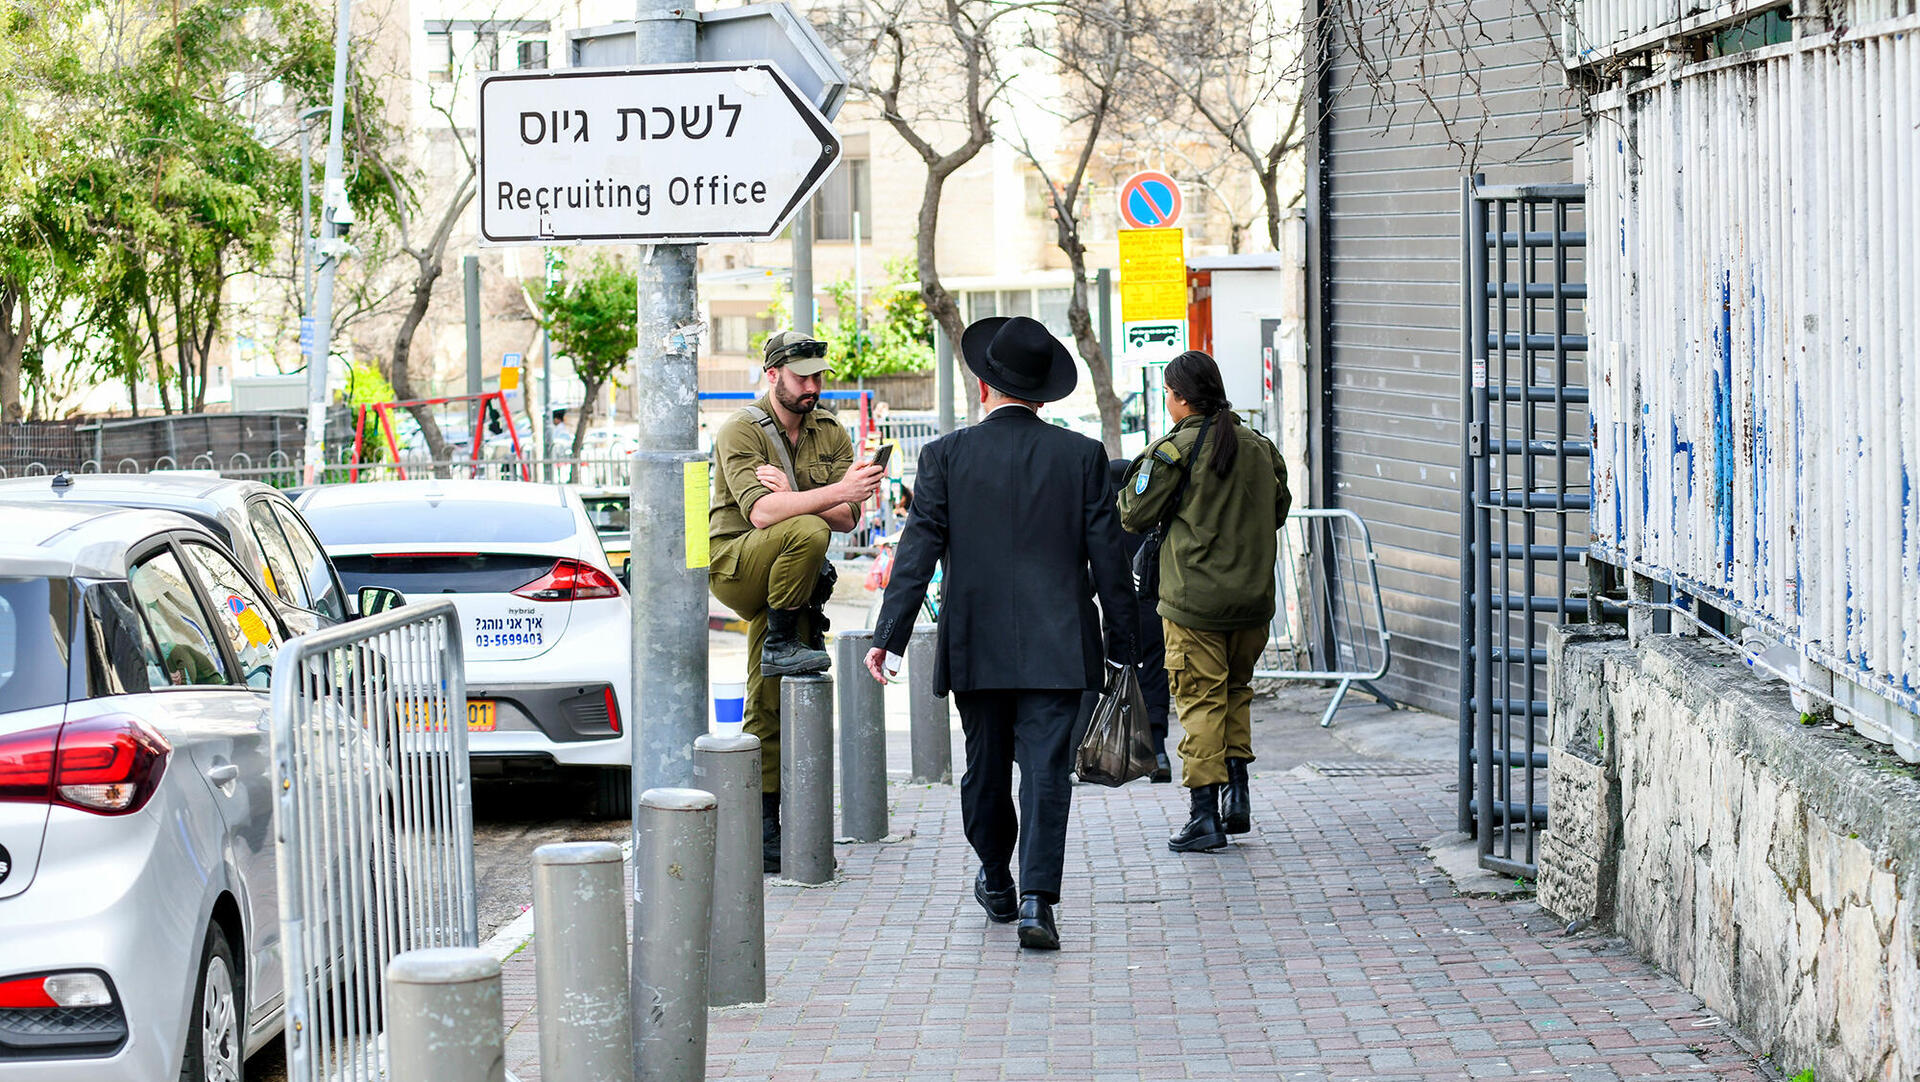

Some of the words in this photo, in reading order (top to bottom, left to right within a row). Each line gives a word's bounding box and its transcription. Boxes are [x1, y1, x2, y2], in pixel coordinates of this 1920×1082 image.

[616, 93, 742, 142] לשכת
[519, 109, 590, 145] גיוס
[497, 177, 651, 216] Recruiting
[668, 175, 767, 206] Office
[475, 618, 504, 631] נוהג?
[506, 618, 523, 630] אני
[525, 617, 543, 632] איך
[475, 633, 543, 647] 03-5699403
